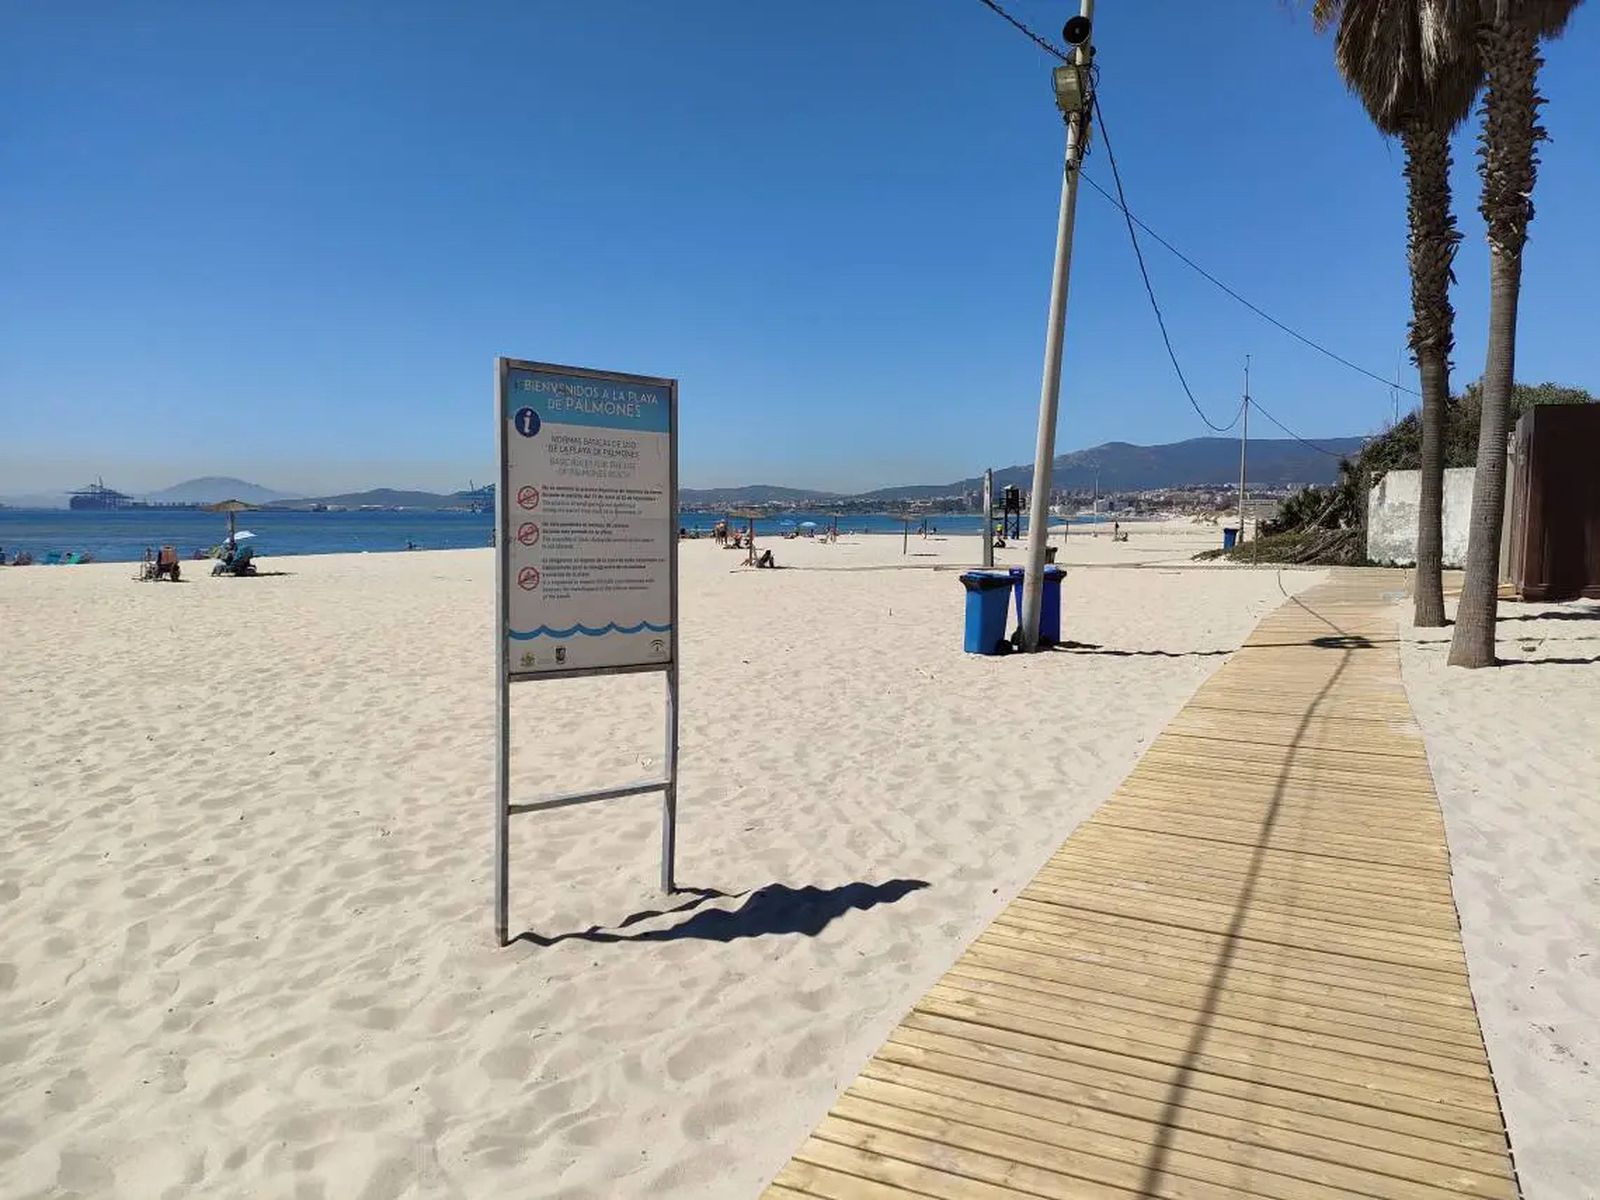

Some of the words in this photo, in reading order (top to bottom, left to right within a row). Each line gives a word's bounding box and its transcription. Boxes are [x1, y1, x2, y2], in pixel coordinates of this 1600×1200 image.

[524, 379, 598, 398] BIENVENIDOS
[602, 390, 610, 400] A
[612, 389, 626, 401] LA
[628, 391, 660, 405] PLAYA
[547, 397, 562, 410] DE
[565, 397, 641, 417] PALMONES
